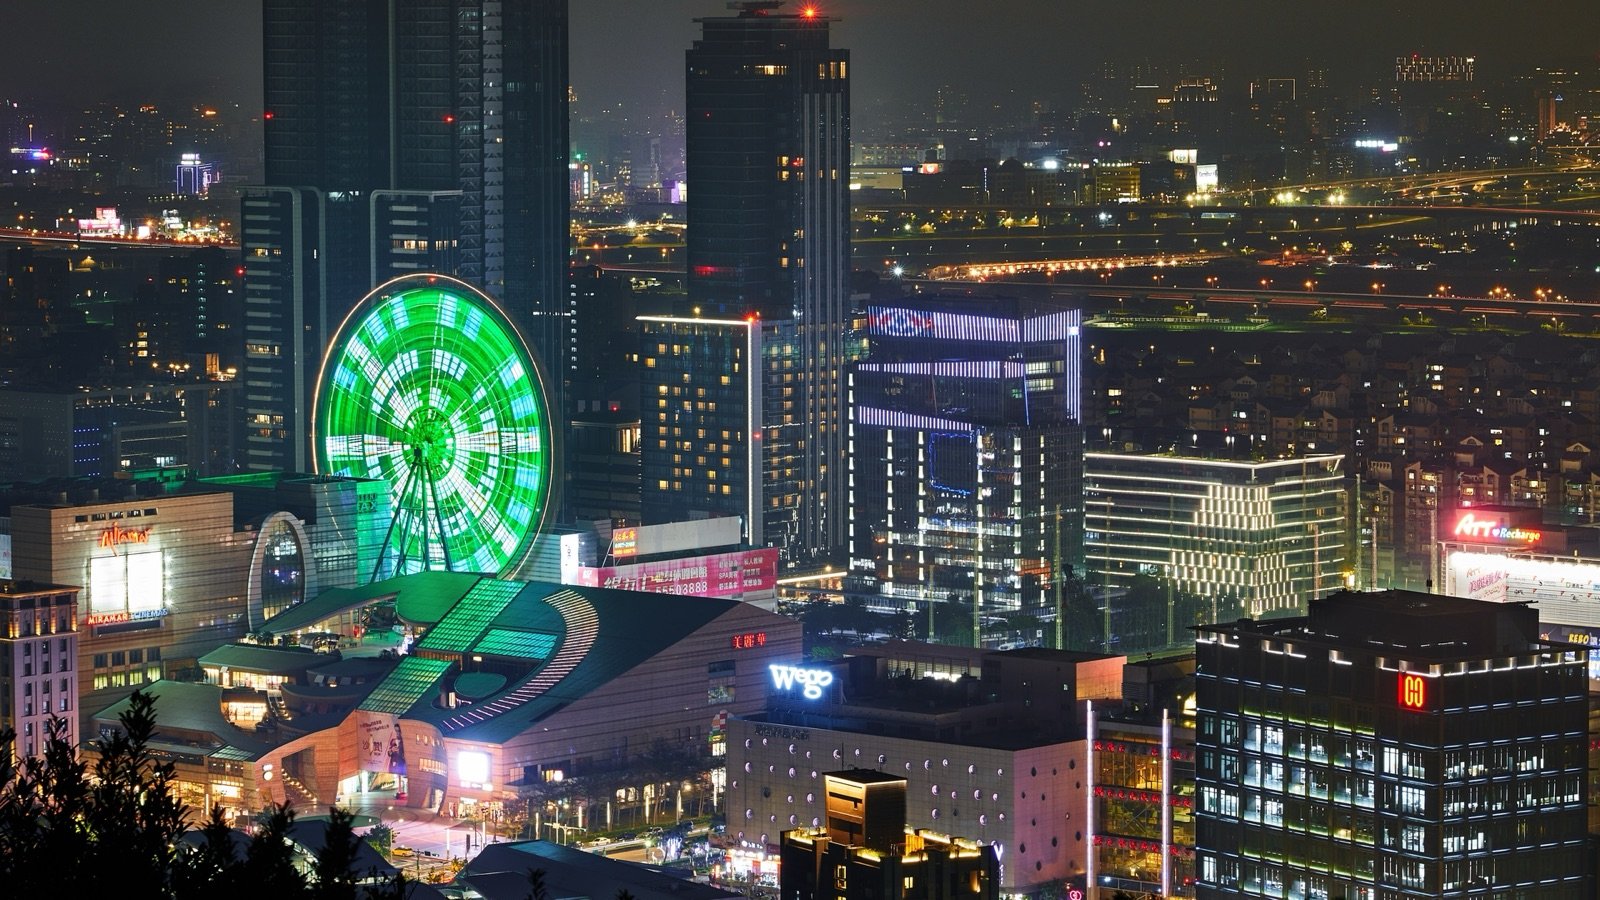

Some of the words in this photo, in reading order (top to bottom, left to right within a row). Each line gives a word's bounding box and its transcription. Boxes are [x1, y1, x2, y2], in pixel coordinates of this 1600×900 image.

[100, 521, 153, 557] Miramar
[1455, 513, 1496, 538] ATT
[1500, 528, 1541, 542] Recharge
[87, 612, 129, 625] MIRAMAR
[133, 608, 168, 620] CINEMAS
[769, 664, 833, 699] Wego
